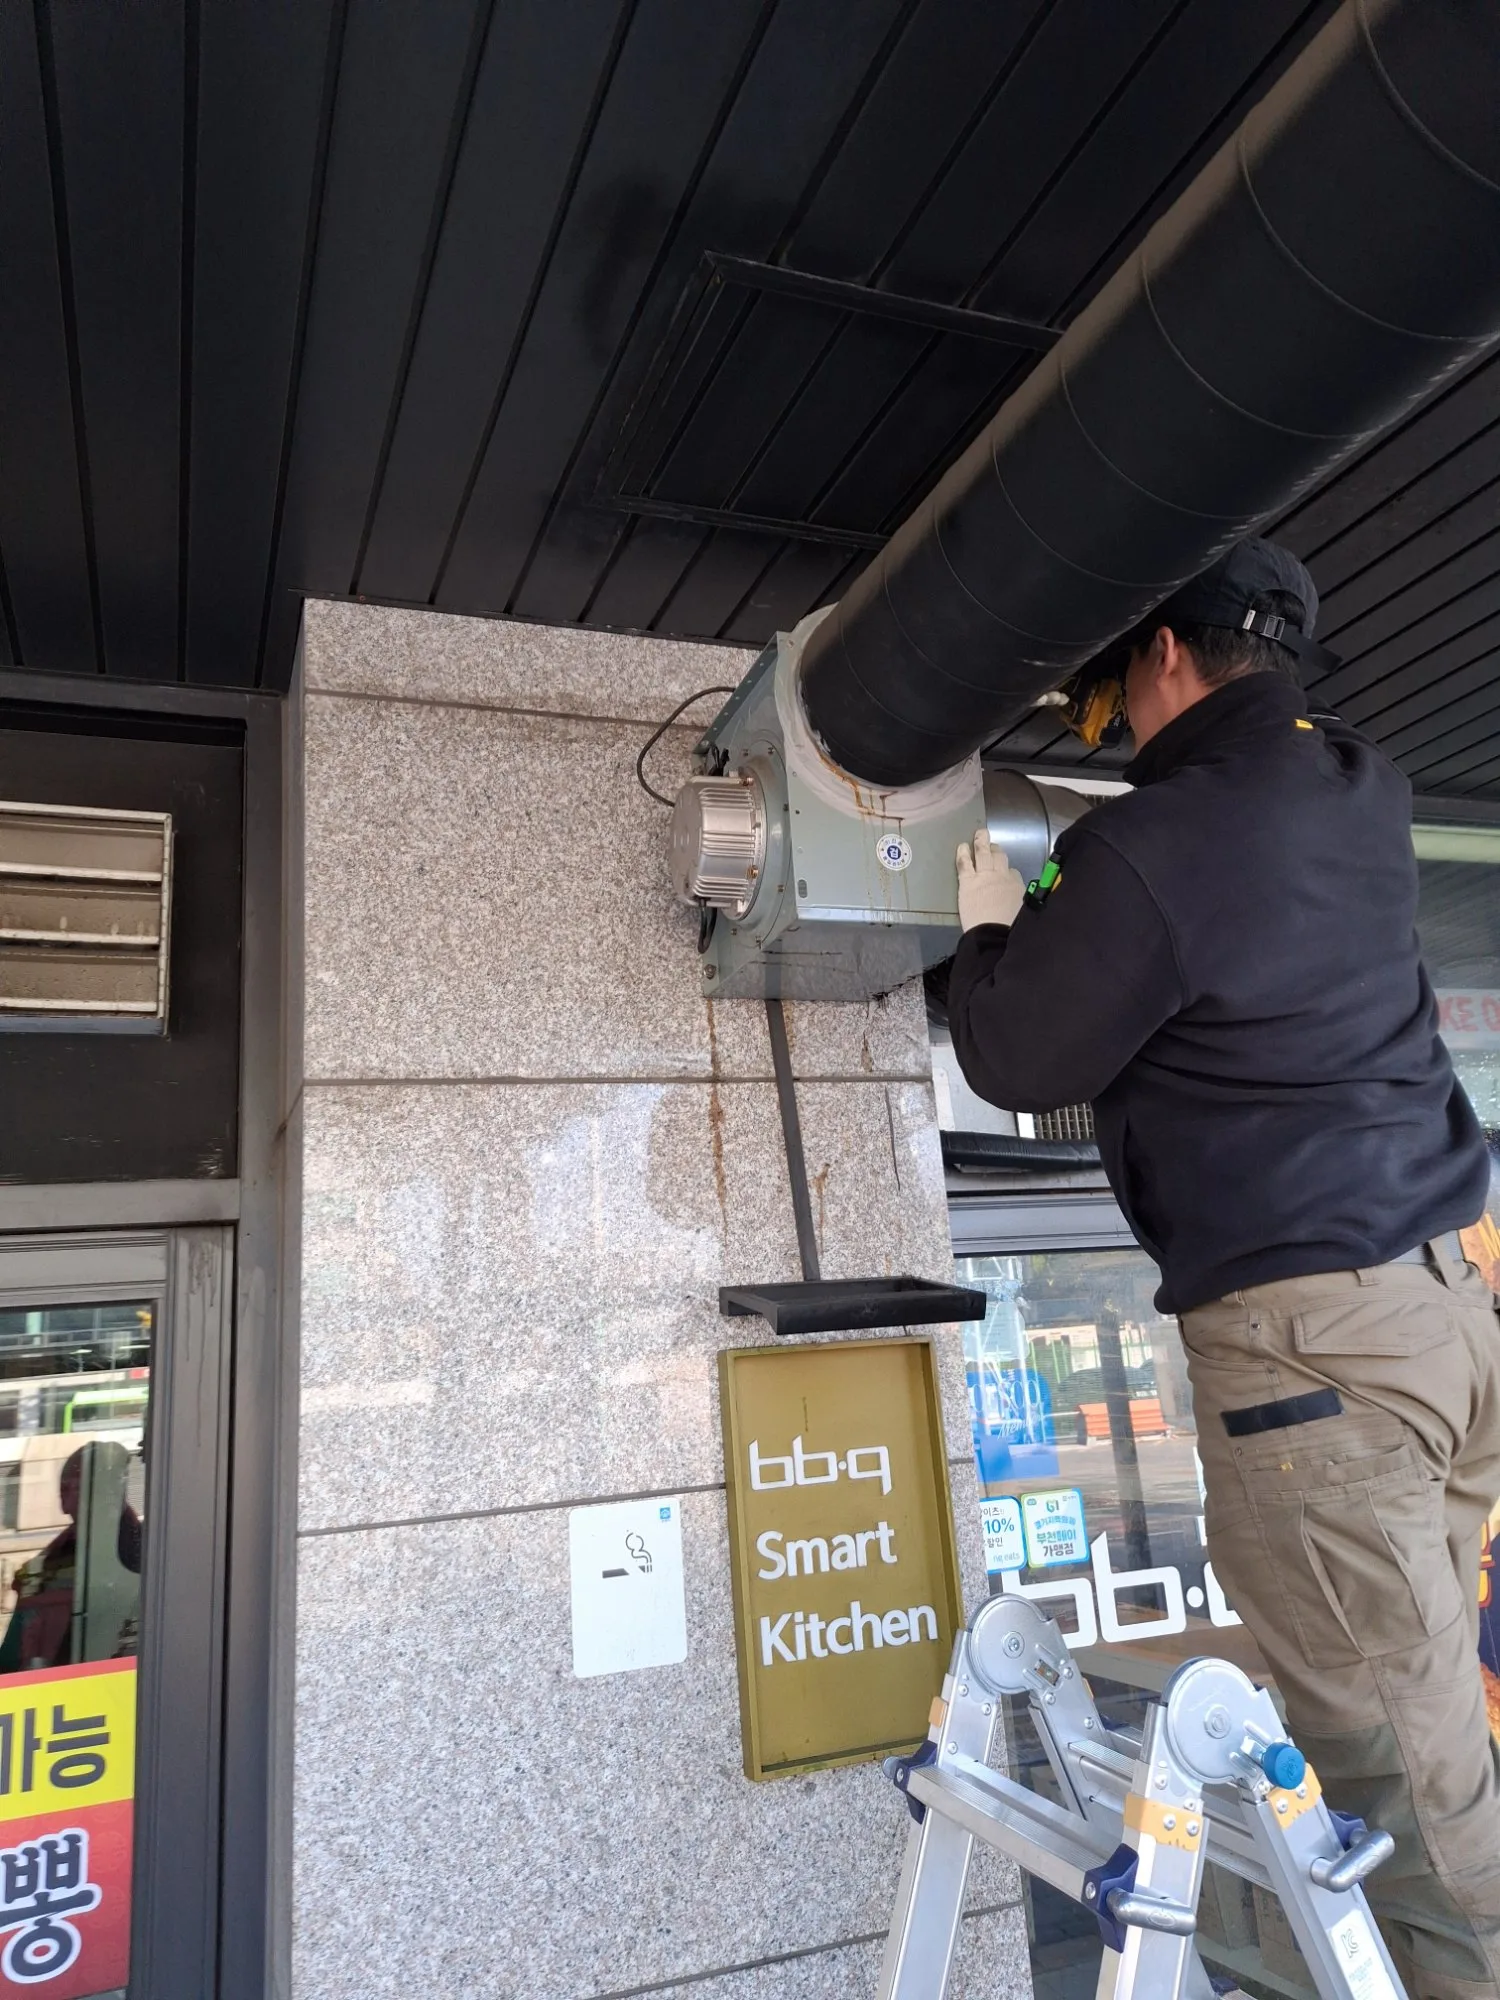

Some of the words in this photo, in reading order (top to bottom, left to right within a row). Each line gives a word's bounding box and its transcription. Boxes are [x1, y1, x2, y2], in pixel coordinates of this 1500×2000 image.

[1438, 995, 1479, 1032] KE
[983, 1517, 1015, 1535] 10%
[1036, 1529, 1076, 1545] 부천페이
[756, 1520, 898, 1580] Smart
[1042, 1543, 1075, 1557] 가맹점
[760, 1600, 938, 1666] Kitchen
[0, 1704, 111, 1797] 가능
